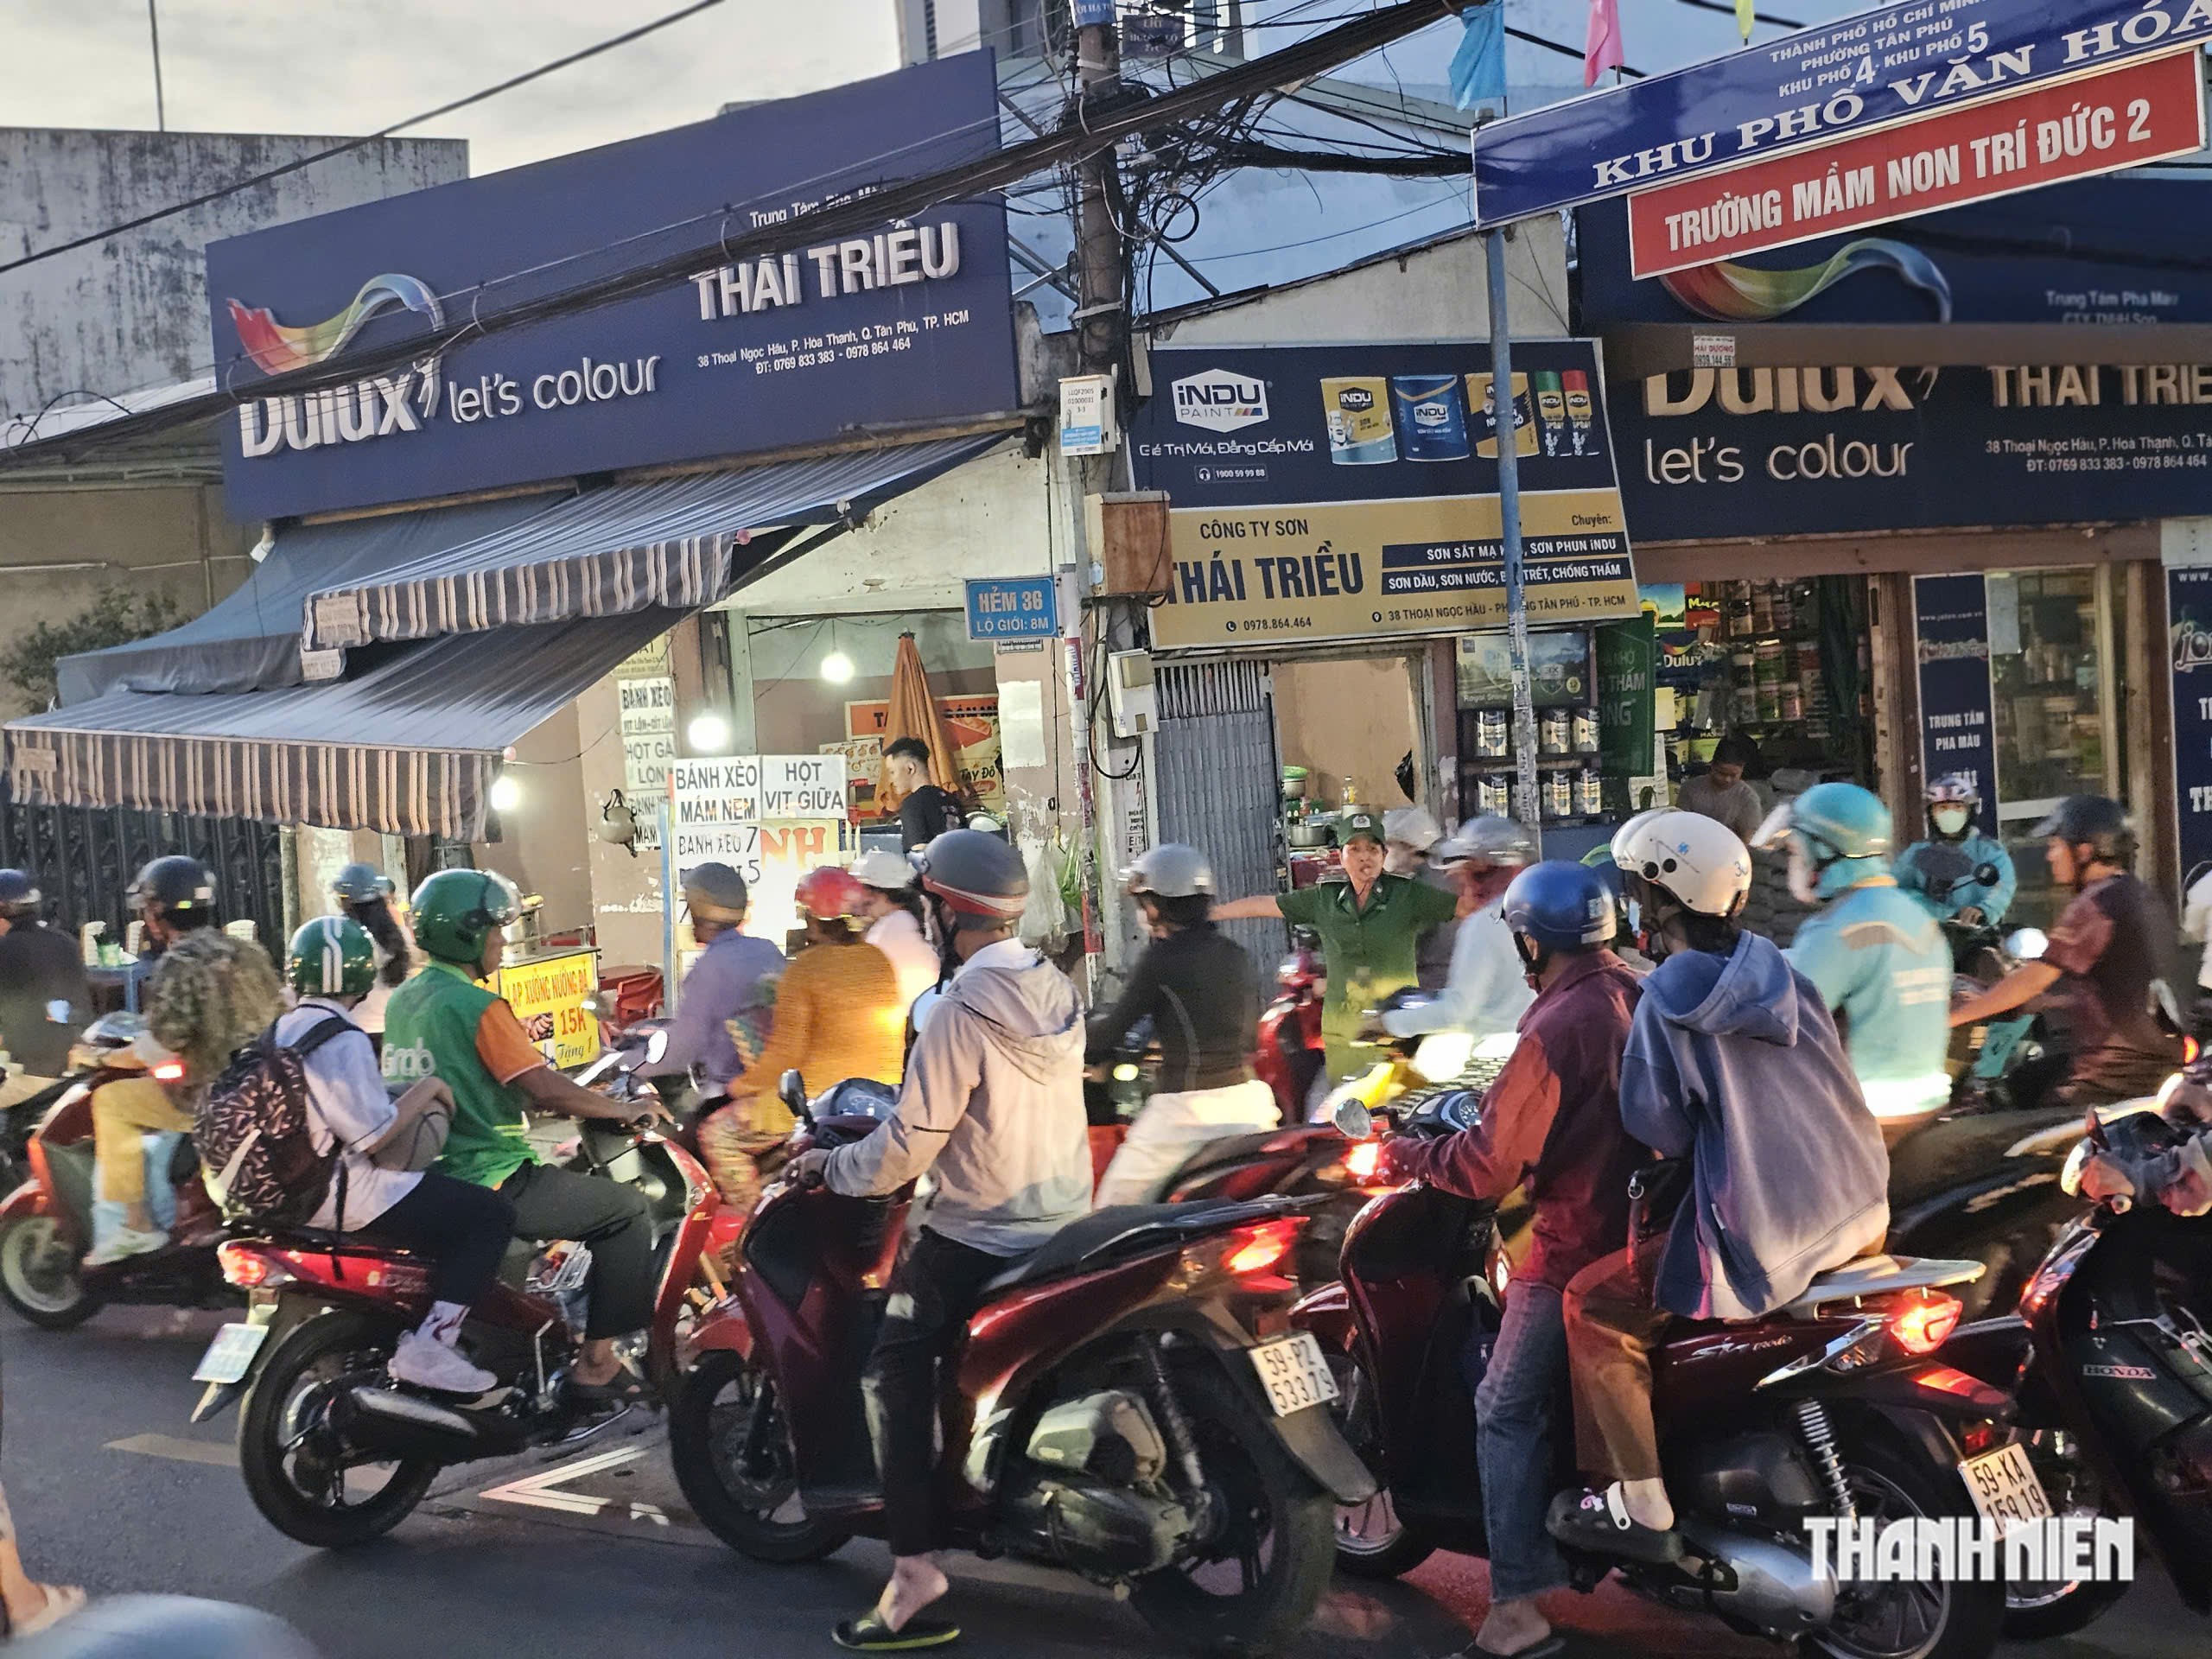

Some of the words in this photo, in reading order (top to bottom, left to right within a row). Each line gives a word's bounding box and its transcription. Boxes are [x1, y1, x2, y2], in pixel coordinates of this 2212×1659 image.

[1770, 35, 1826, 63] THÀNH
[1831, 21, 1867, 45] PHỐ
[1872, 12, 1897, 34] HỒ
[1903, 3, 1934, 24] CHÍ
[1801, 42, 1871, 72] PHƯỜNG
[1874, 30, 1911, 50] TÂN
[1916, 16, 1953, 39] PHÚ
[1778, 80, 1812, 98] KHU
[1817, 64, 1853, 86] PHỐ
[1855, 54, 1876, 85] 4
[1884, 47, 1921, 68] KHU
[1925, 29, 1963, 56] PHỐ
[1967, 21, 1989, 54] 5
[1592, 131, 1716, 189] KHU
[1736, 82, 1864, 151] PHỐ
[1888, 44, 2036, 106] VĂN
[2062, 0, 2212, 64] HÓA
[1664, 189, 1782, 252] TRƯỜNG
[1792, 160, 1875, 223] MẦM
[1887, 144, 1960, 200] NON
[1969, 118, 2028, 180] TRÍ
[2037, 101, 2116, 165] ĐỨC
[2126, 99, 2152, 143] 2
[749, 208, 787, 228] Trung
[808, 219, 959, 298] TRIỀU
[697, 355, 709, 368] 38
[741, 347, 765, 363] Ngọc
[791, 340, 800, 352] P.
[826, 330, 858, 347] Thạnh,
[861, 327, 873, 340] Q.
[874, 324, 893, 338] Tân
[897, 321, 919, 334] Phú,
[923, 315, 940, 330] TP.
[944, 309, 969, 327] HCM
[755, 360, 772, 374] ĐT:
[774, 356, 797, 372] 0769
[798, 353, 816, 368] 833
[817, 349, 835, 365] 383
[846, 344, 869, 359] 0978
[871, 340, 889, 355] 864
[892, 337, 911, 352] 464
[448, 372, 523, 423] let's
[533, 354, 661, 411] colour
[1180, 407, 1232, 418] PAINT
[1164, 443, 1185, 457] Trị
[1257, 438, 1286, 454] Cấp
[1645, 436, 1745, 485] let's
[1767, 433, 1914, 480] colour
[1985, 440, 2001, 454] 38
[2003, 439, 2036, 456] Thoại
[2037, 439, 2069, 455] Ngọc
[2099, 438, 2111, 450] P.
[1216, 469, 1234, 479] 1900
[1235, 469, 1244, 478] 59
[2049, 458, 2077, 472] 0769
[2080, 457, 2101, 471] 833
[2103, 456, 2124, 469] 383
[2132, 454, 2161, 469] 0978
[2163, 454, 2184, 468] 864
[2186, 454, 2208, 467] 464
[1200, 519, 1245, 539] CÔNG
[1249, 520, 1270, 537] TY
[1275, 518, 1309, 537] SƠN
[1572, 514, 1612, 527] Chuyên:
[1427, 547, 1451, 561] SƠN
[1478, 544, 1497, 559] MẠ
[1530, 541, 1554, 555] SƠN
[1556, 539, 1588, 552] PHUN
[1255, 540, 1364, 600] TRIỀU
[1389, 576, 1411, 589] SƠN
[1414, 572, 1439, 588] DẦU,
[1440, 573, 1464, 586] SƠN
[1465, 569, 1499, 585] NƯỚC,
[1522, 566, 1551, 581] TRÉT,
[1553, 563, 1589, 579] CHỐNG
[1589, 561, 1621, 576] THẤM
[978, 586, 1017, 613] HẺM
[1021, 590, 1043, 612] 36
[1389, 610, 1401, 621] 38
[1402, 607, 1433, 621] THOẠI
[1435, 606, 1463, 619] NGỌC
[1538, 597, 1558, 610] TÂN
[1560, 596, 1580, 609] PHÚ
[1587, 596, 1601, 607] TP.
[1604, 594, 1626, 606] HCM
[976, 617, 994, 635] LỘ
[997, 615, 1028, 632] GIỚI:
[1030, 617, 1049, 630] 8M
[1243, 616, 1312, 632] 0978.864.464
[1663, 654, 1702, 668] Dulux
[622, 682, 648, 709] BÁNH
[650, 680, 672, 708] XÈO
[1929, 714, 1961, 729] TRUNG
[1963, 710, 1985, 726] TÂM
[1936, 736, 1955, 751] PHA
[1958, 733, 1980, 749] MÀU
[677, 763, 720, 790] BÁNH
[725, 760, 758, 787] XÈO
[785, 760, 822, 786] HỘT
[982, 765, 995, 779] ĐÔ
[765, 790, 792, 815] VỊT
[798, 787, 843, 810] GIỮA
[2086, 1366, 2155, 1379] HONDA
